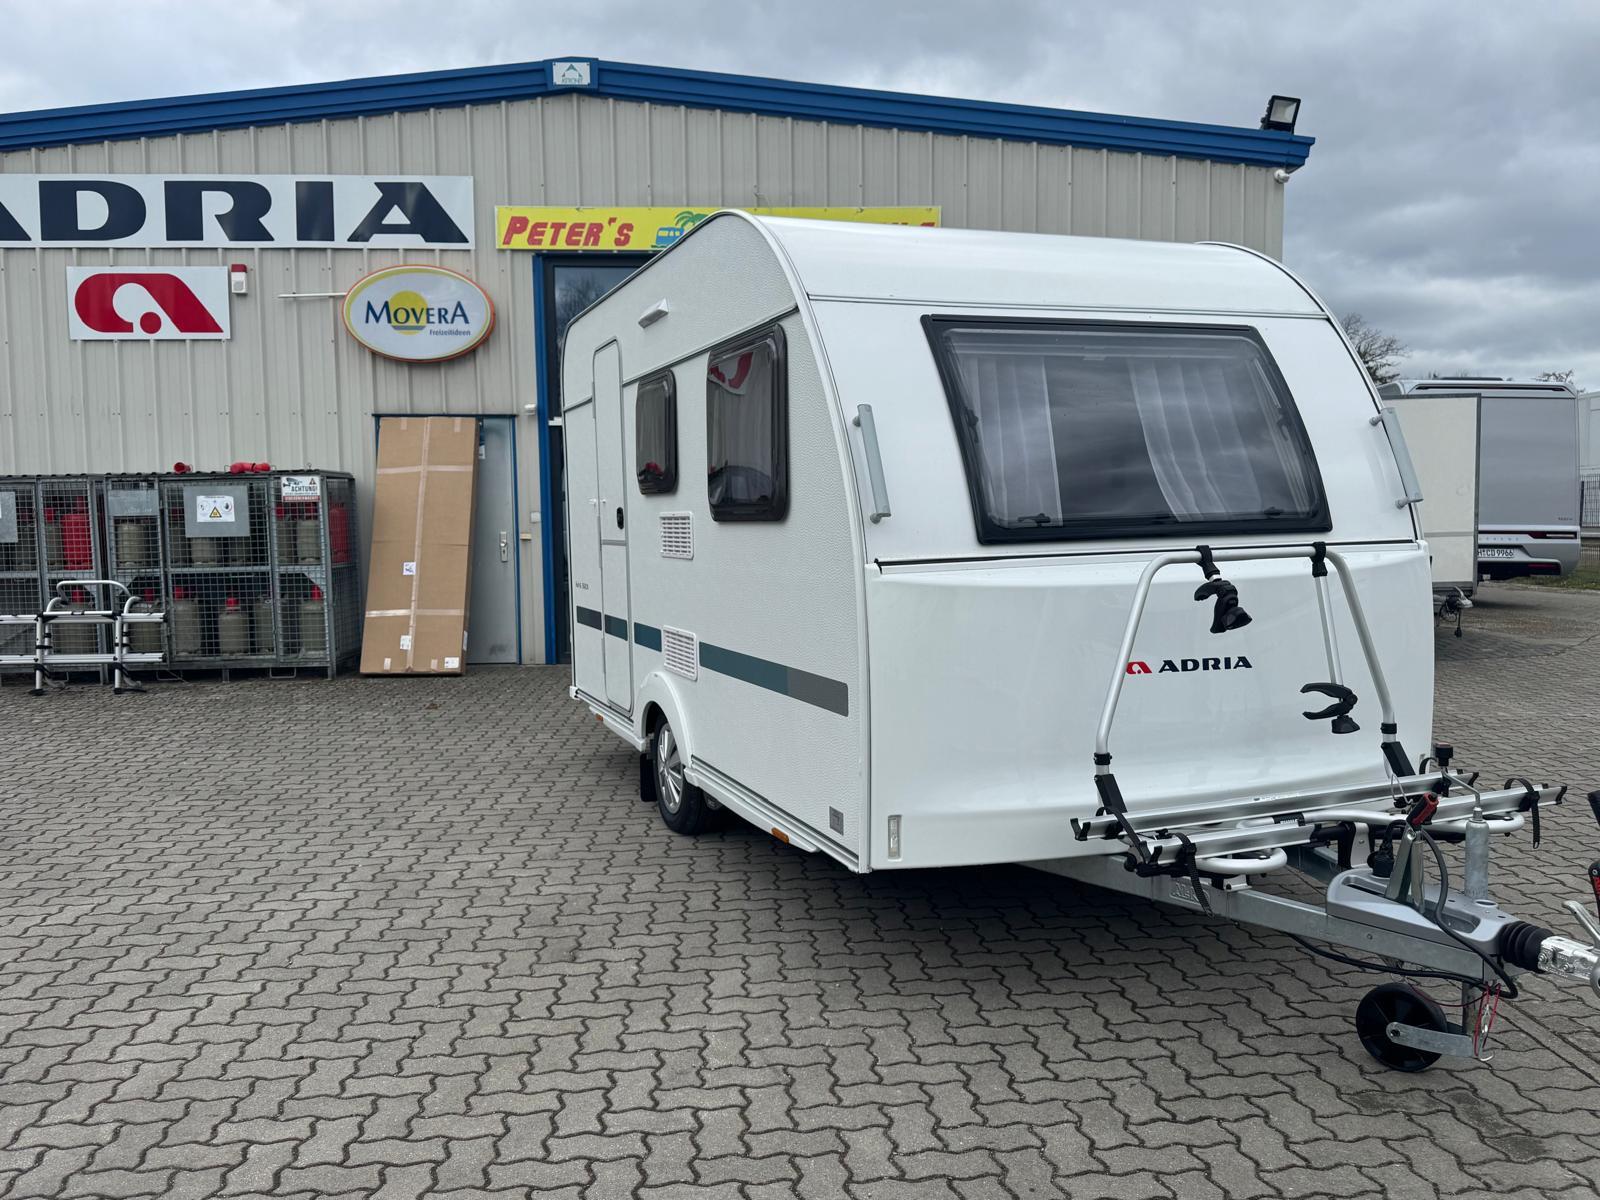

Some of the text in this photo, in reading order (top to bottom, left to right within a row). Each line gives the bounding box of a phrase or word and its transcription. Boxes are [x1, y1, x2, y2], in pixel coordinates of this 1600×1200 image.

[0, 180, 469, 243] DRIA
[502, 216, 634, 246] PETER'S
[1158, 656, 1252, 673] ADRIA
